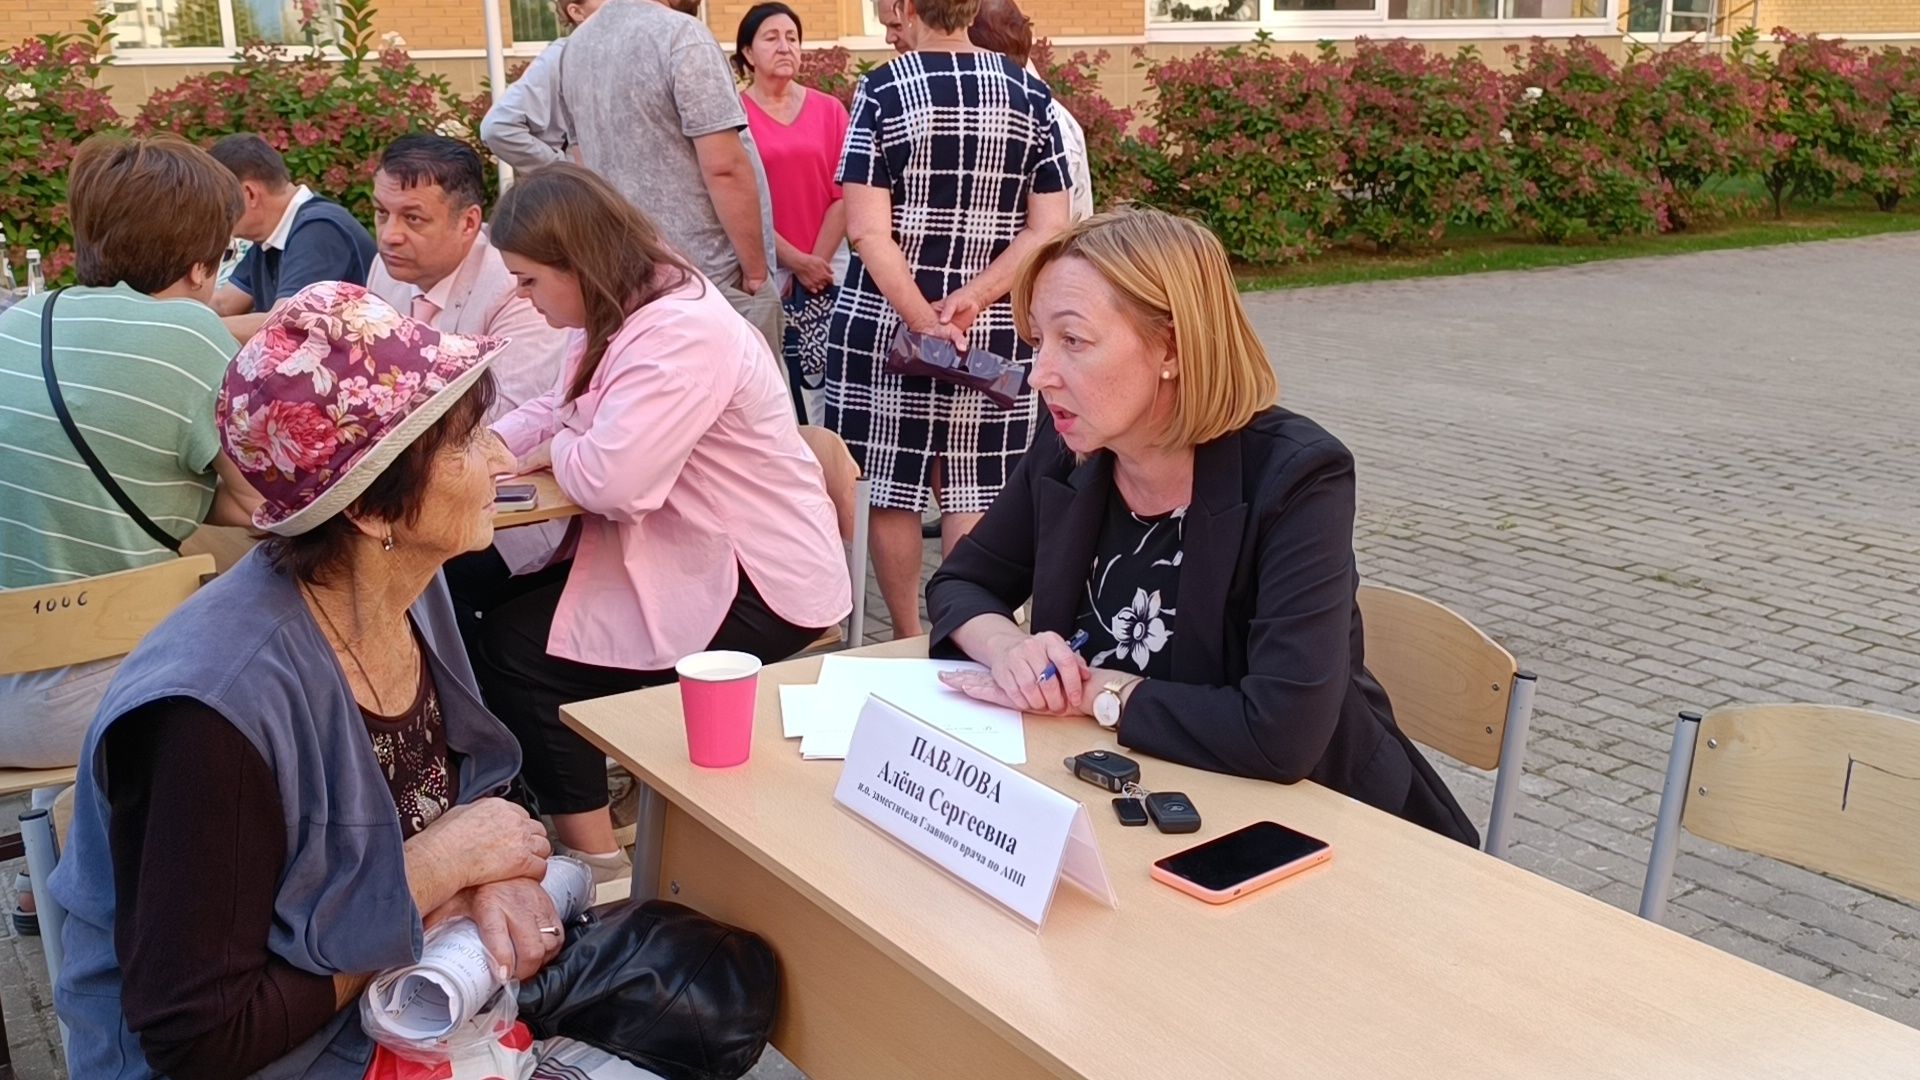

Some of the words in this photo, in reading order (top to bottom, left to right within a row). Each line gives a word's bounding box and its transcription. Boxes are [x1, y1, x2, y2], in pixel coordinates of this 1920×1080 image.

[877, 760, 924, 802] Алёна
[929, 788, 1018, 855] Сергеевна
[910, 735, 1002, 804] ПАВЛОВА
[872, 790, 919, 825] заместителя
[918, 816, 959, 849] Главного
[959, 841, 986, 865] врача
[987, 858, 1000, 873] по
[1000, 865, 1027, 887] АПП
